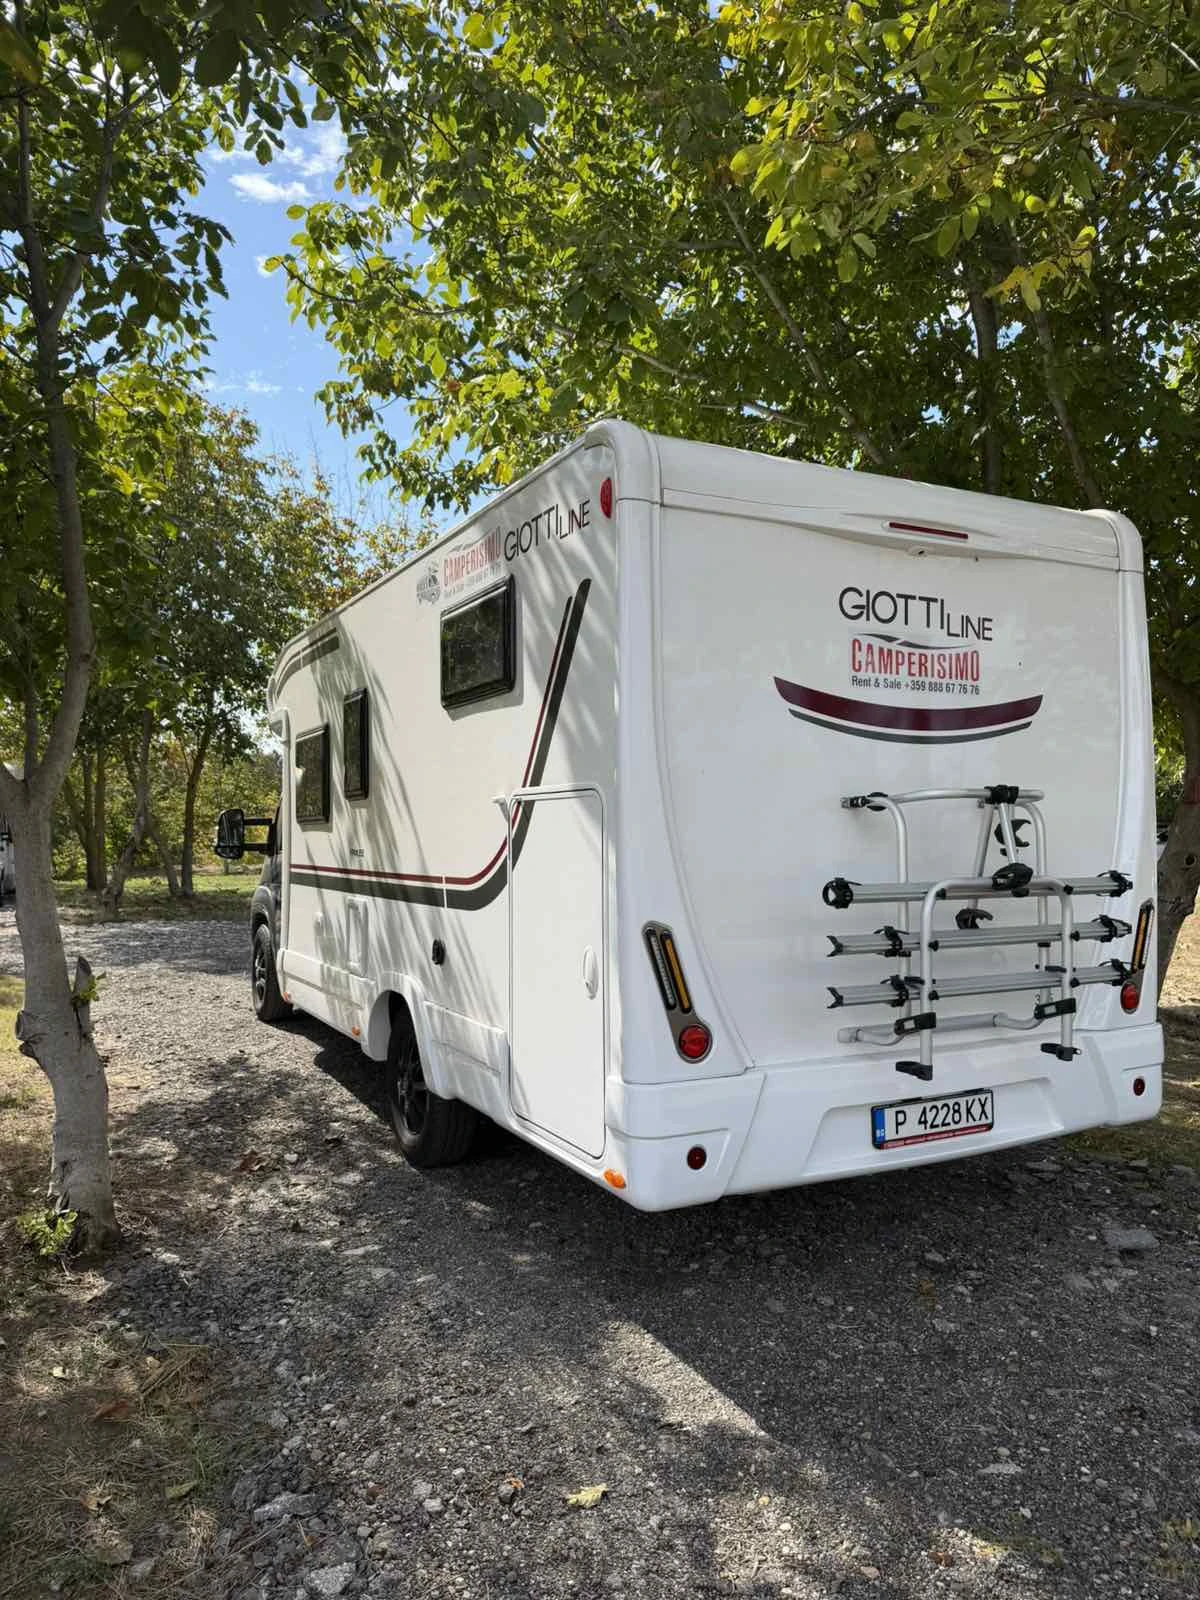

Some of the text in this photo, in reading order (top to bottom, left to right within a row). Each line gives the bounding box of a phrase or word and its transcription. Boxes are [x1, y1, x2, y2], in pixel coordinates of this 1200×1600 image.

[851, 638, 980, 682] CAMPERISIMO
[851, 675, 980, 696] Rent & Sale +359 888 67 76 76
[895, 1109, 907, 1135] P
